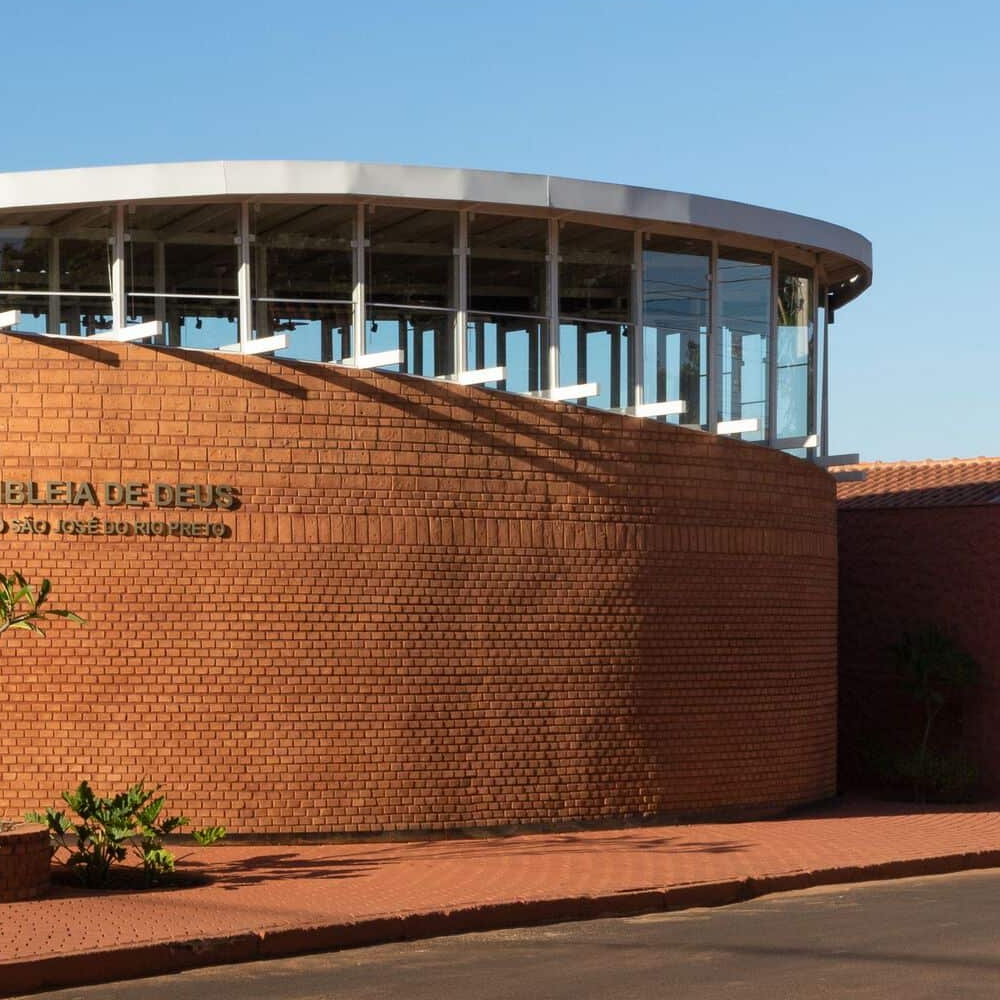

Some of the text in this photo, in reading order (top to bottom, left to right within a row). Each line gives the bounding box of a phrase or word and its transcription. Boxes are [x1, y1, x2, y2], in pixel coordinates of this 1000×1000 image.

[104, 482, 144, 506] DE
[154, 482, 234, 509] DEUS
[11, 517, 47, 535] SÃO
[55, 517, 100, 535] JOSÉ
[103, 519, 128, 536] DO
[134, 519, 163, 537] RIO
[168, 520, 225, 538] PRETO
